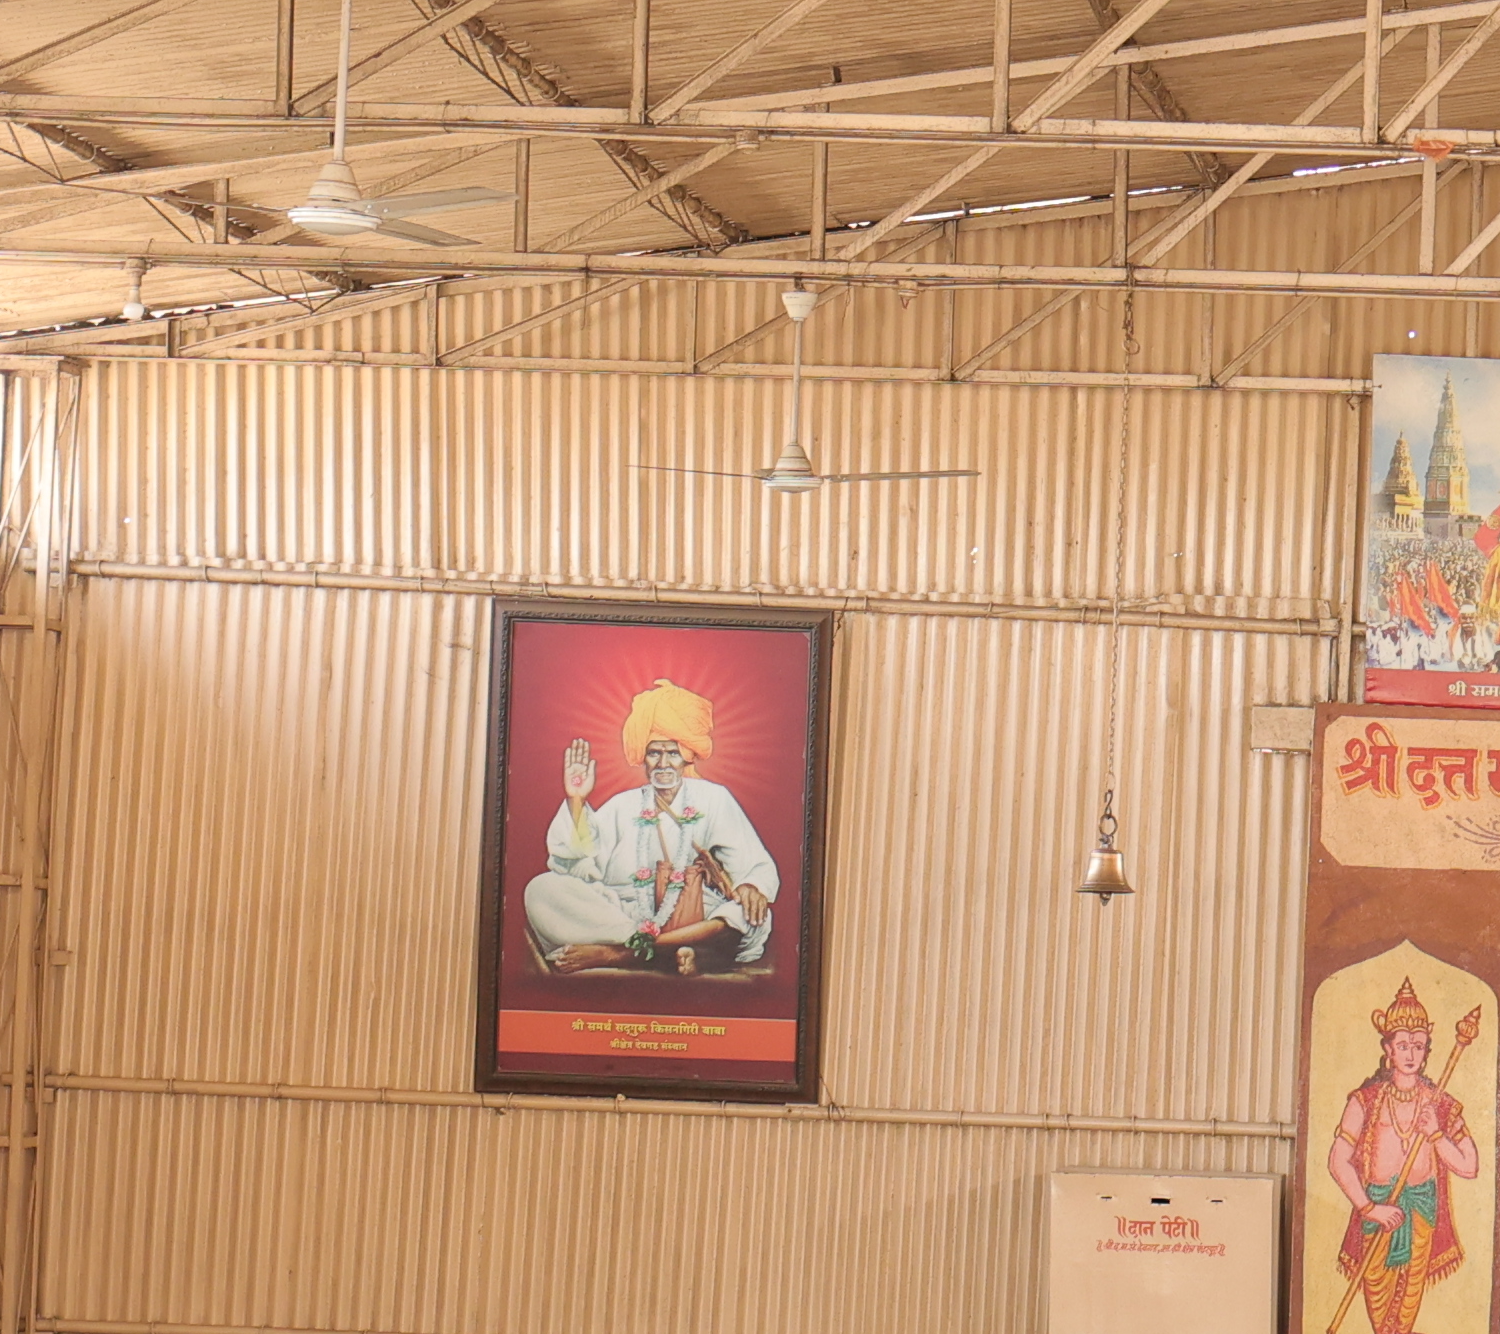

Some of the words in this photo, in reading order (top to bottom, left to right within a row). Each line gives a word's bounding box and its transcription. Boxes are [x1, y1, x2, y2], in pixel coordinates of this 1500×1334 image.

[1448, 680, 1466, 696] श्री
[1337, 722, 1401, 798] श्री
[1406, 746, 1481, 811] दत्त
[571, 1018, 584, 1031] श्री
[650, 1020, 700, 1035] किसनगिरी
[702, 1025, 726, 1036] बाबा
